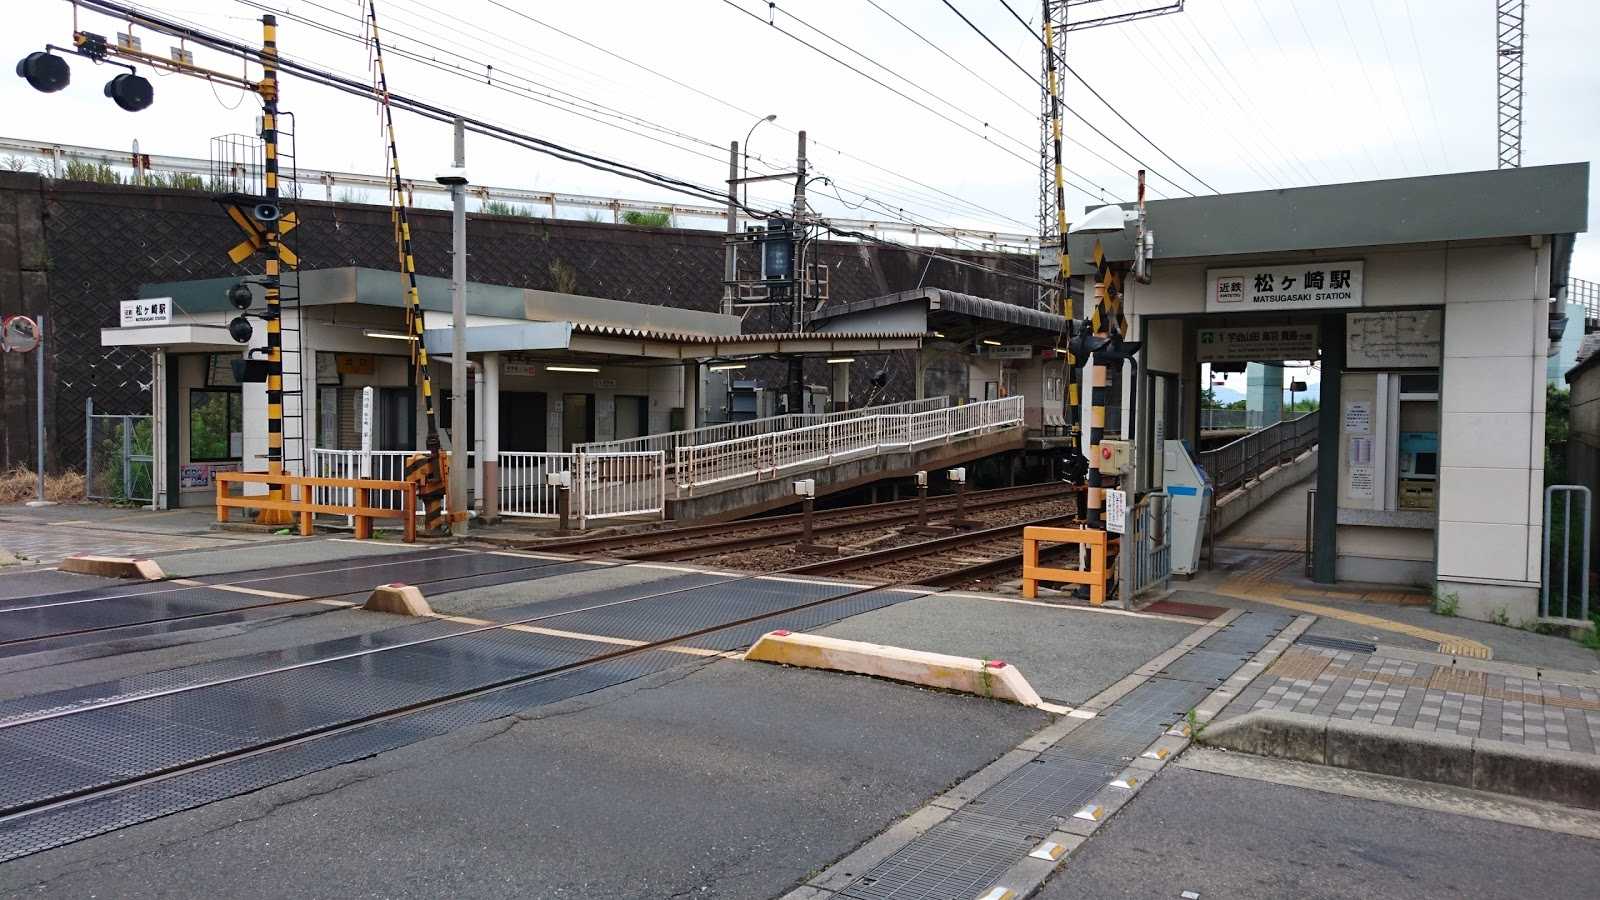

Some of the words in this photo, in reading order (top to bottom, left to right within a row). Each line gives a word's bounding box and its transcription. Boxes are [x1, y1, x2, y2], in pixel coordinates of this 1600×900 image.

[1219, 282, 1242, 293] 近鉄
[1253, 294, 1312, 303] MATSUGASAKI
[1315, 292, 1351, 300] STATION
